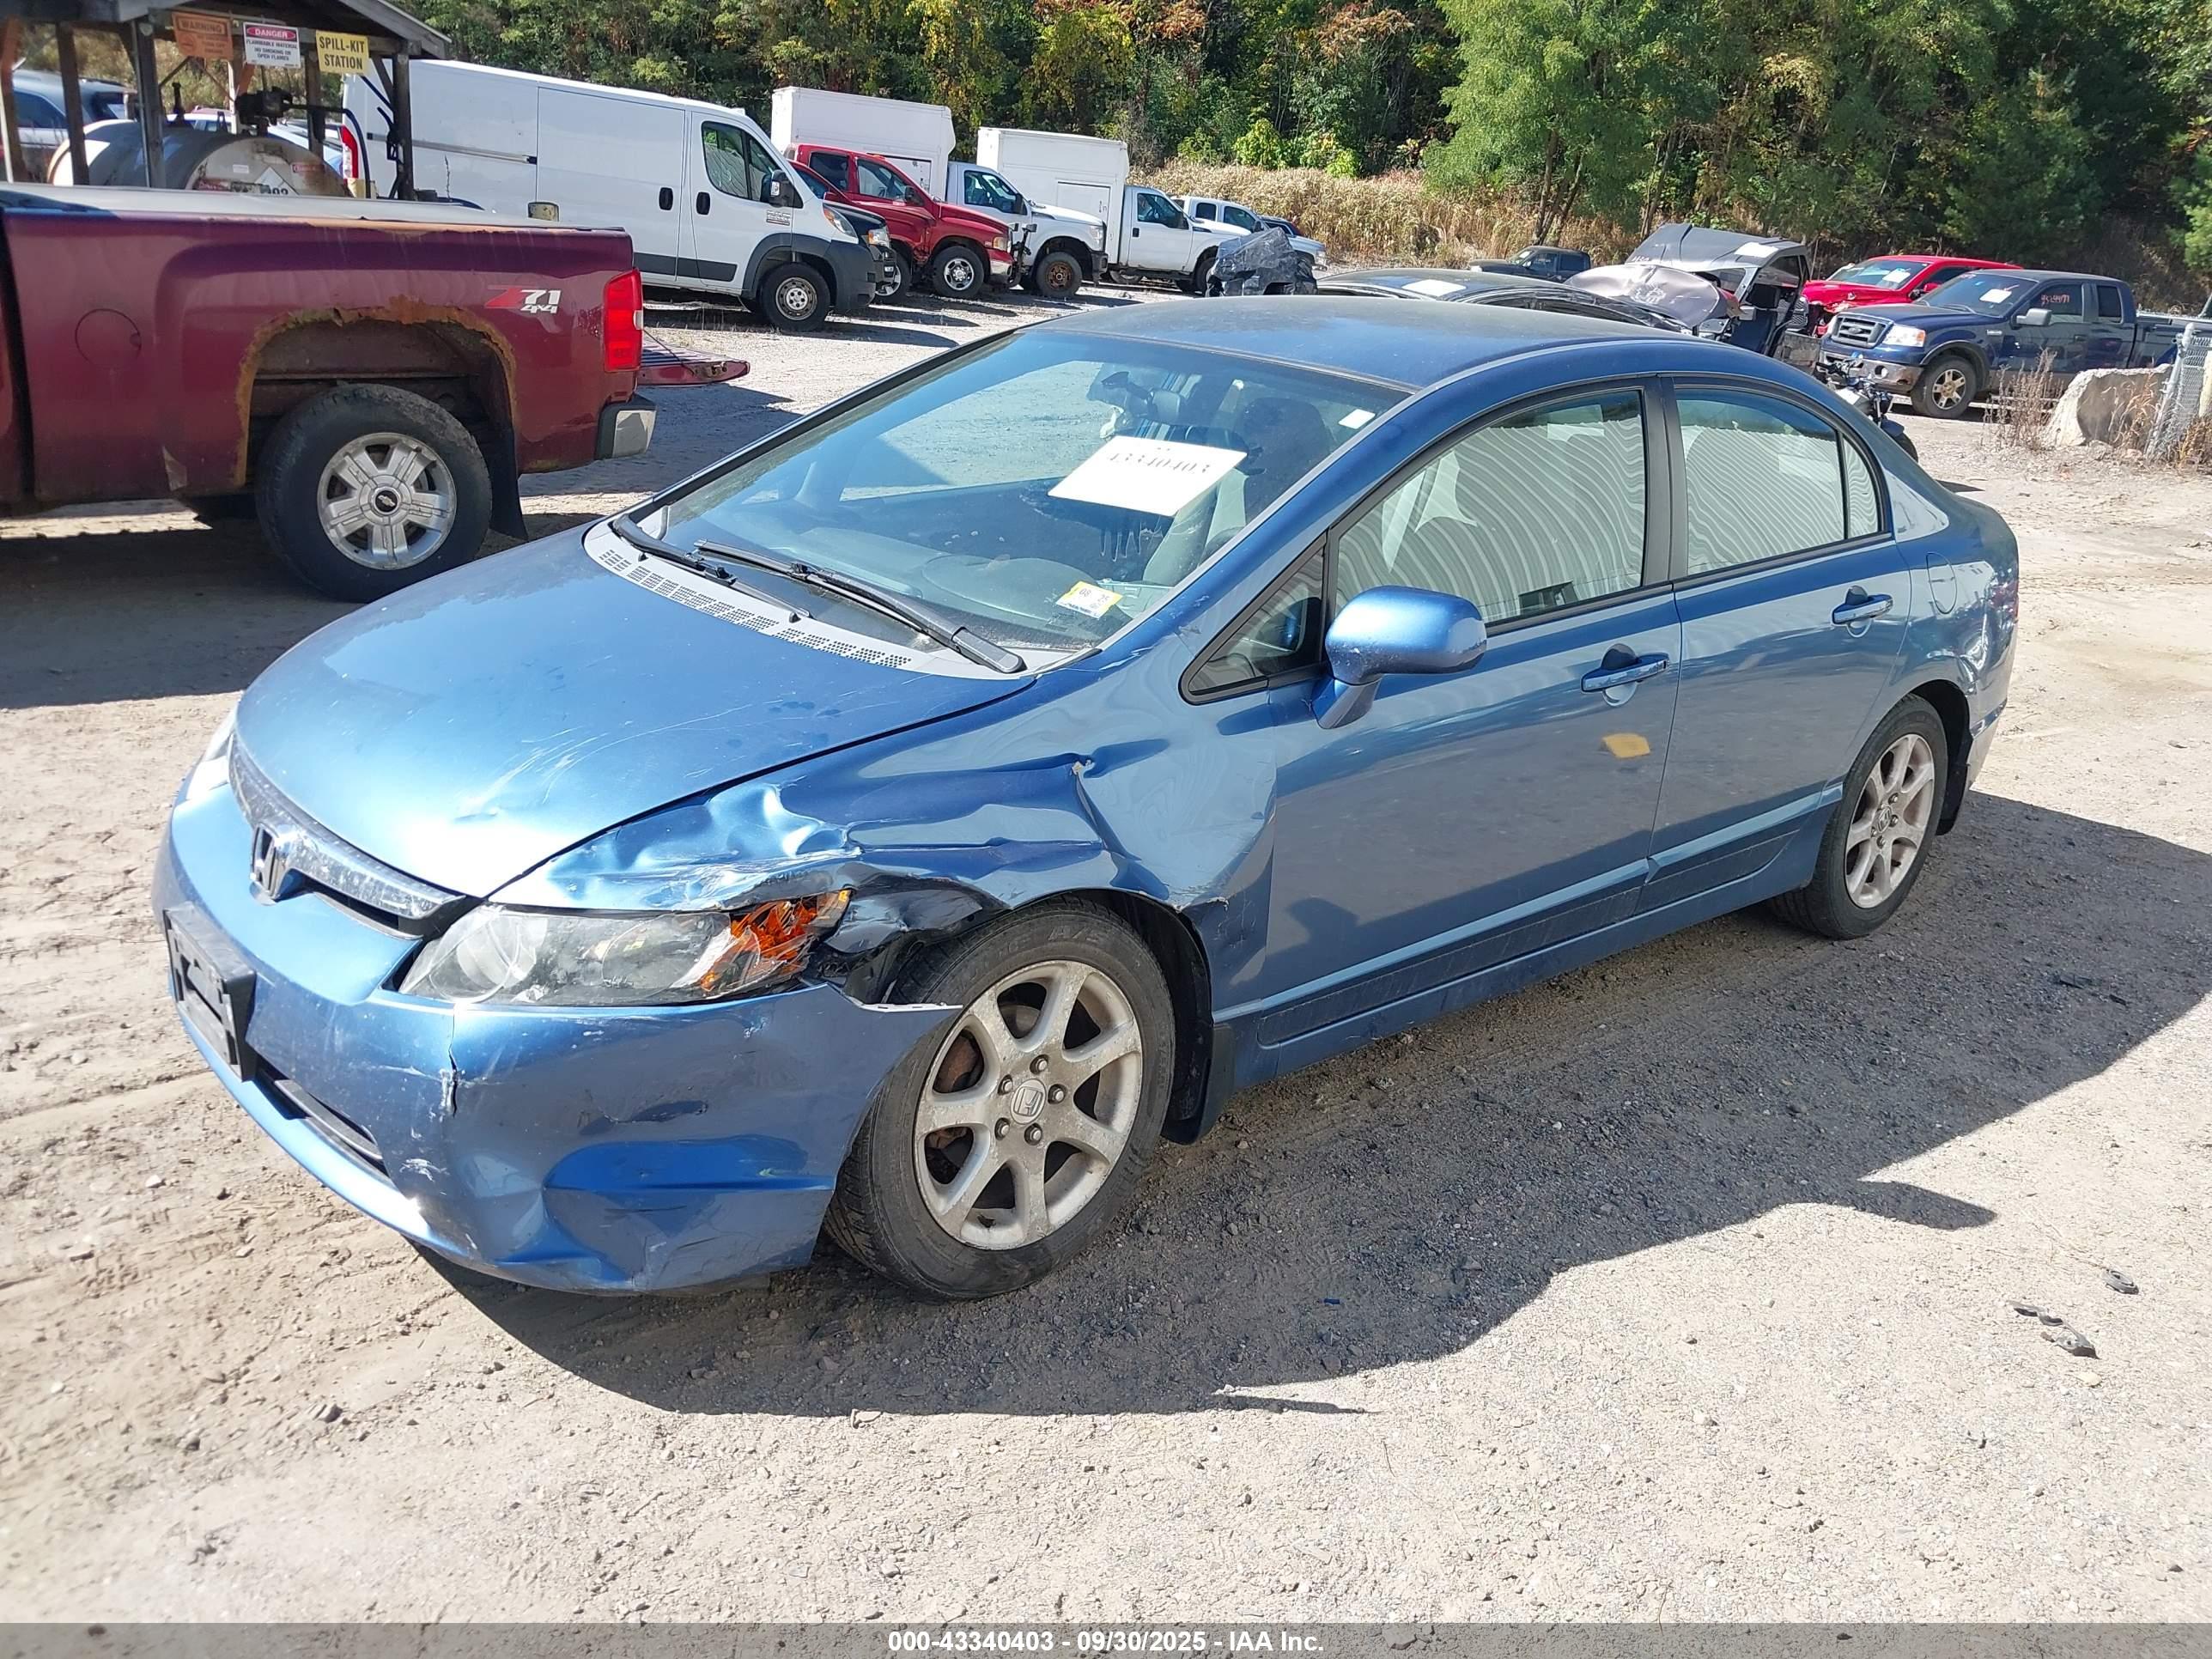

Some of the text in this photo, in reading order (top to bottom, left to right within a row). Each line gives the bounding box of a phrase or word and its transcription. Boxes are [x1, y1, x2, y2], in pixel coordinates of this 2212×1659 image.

[255, 28, 288, 40] DANGER
[319, 36, 364, 53] SPILL-KIT
[325, 53, 363, 70] STATION
